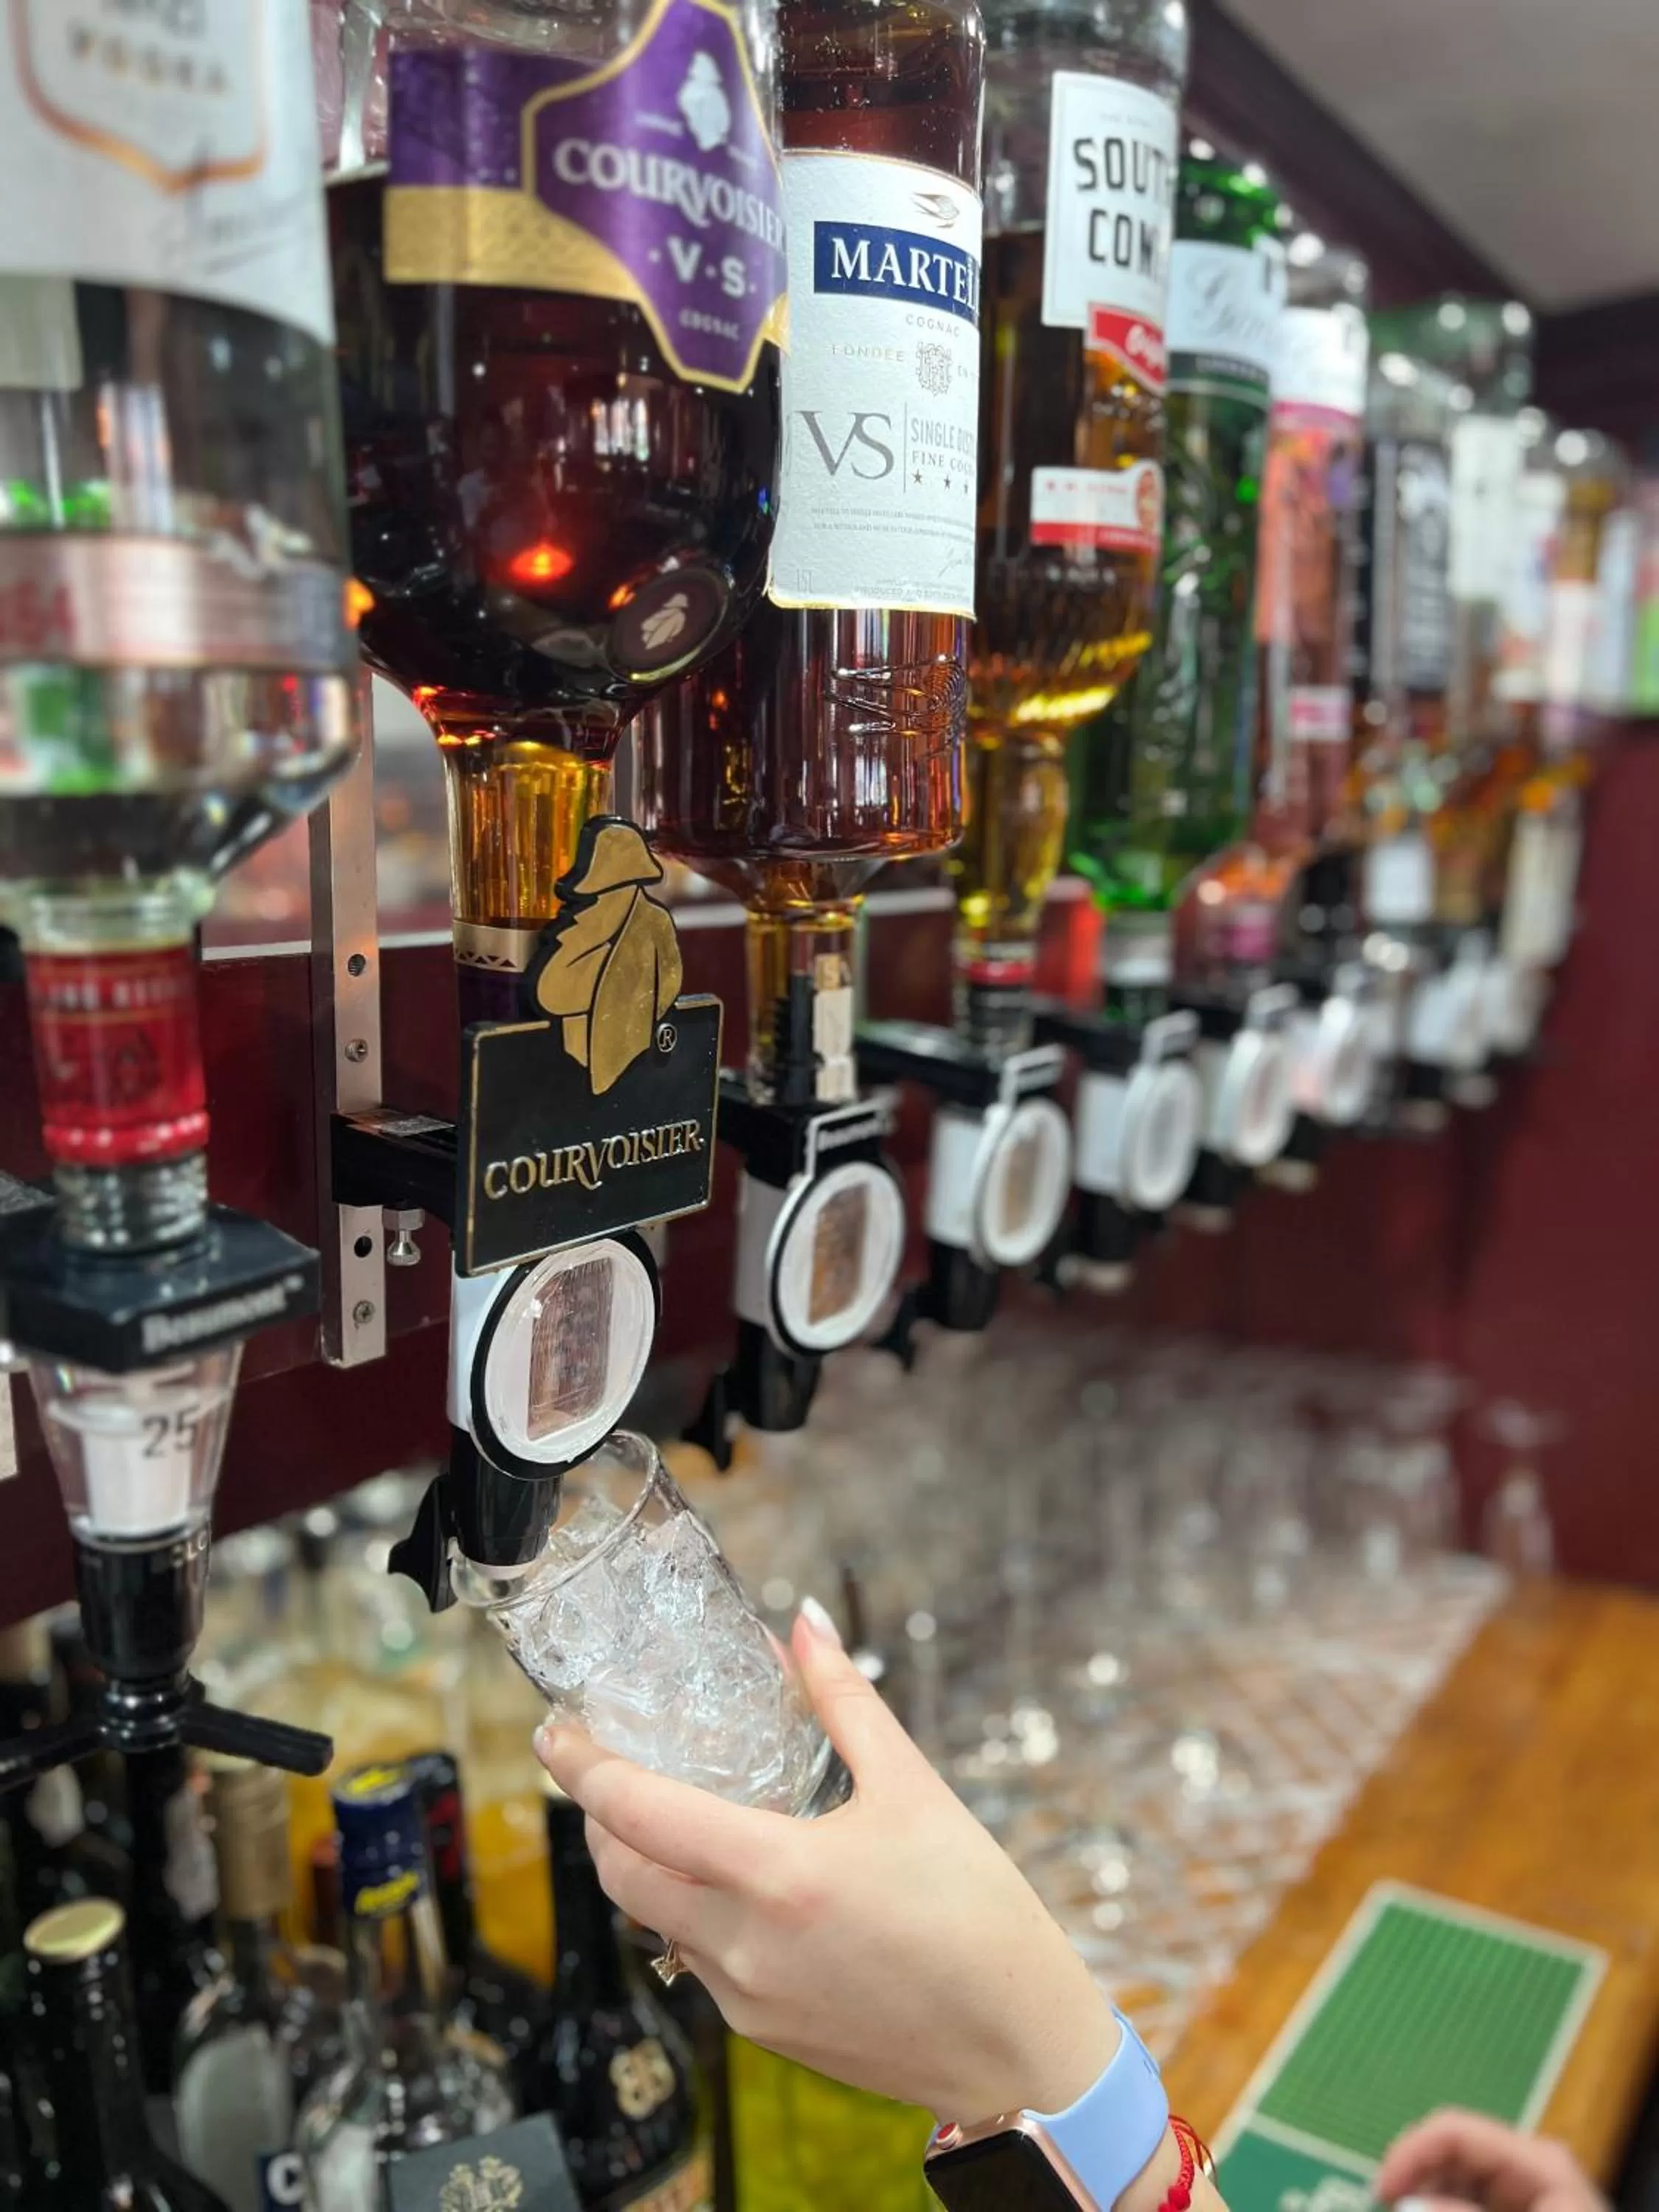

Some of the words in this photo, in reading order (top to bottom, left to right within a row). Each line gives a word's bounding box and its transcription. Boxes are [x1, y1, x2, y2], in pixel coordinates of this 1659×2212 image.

[905, 313, 961, 337] COGNAC
[794, 410, 894, 480] VS
[911, 417, 955, 449] SINGLE
[912, 450, 945, 468] FINE
[484, 1119, 702, 1201] COURVOISIER
[142, 1404, 201, 1458] 25
